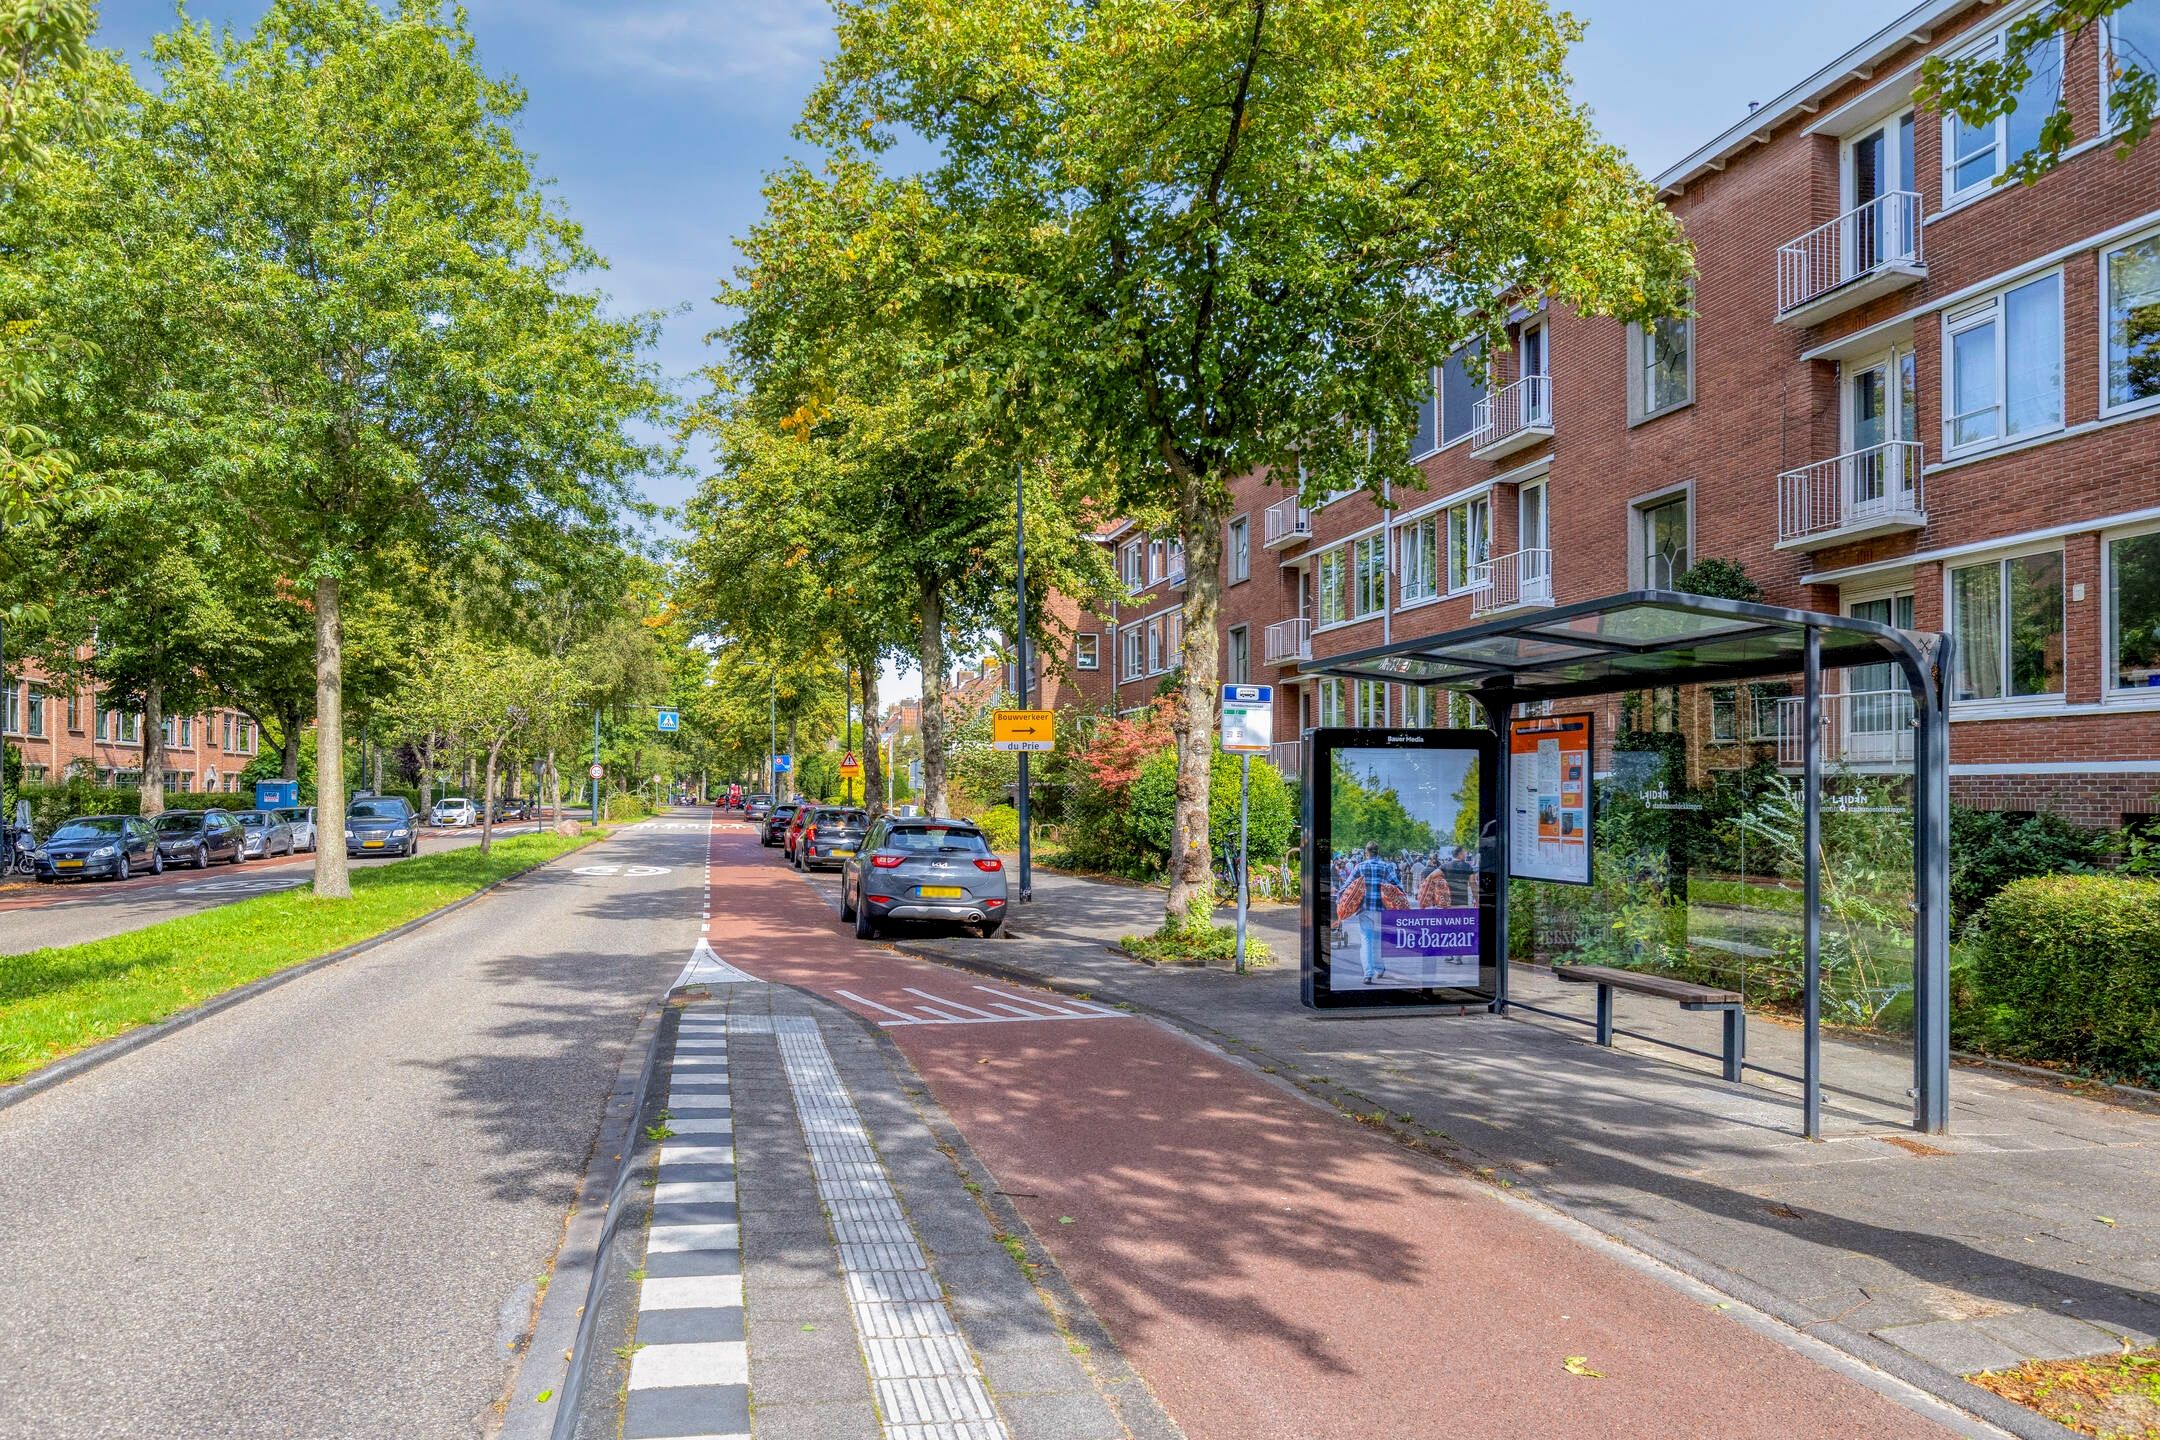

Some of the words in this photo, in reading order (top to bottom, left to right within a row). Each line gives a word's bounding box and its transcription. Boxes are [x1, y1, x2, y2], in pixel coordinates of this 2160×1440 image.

[1007, 742, 1019, 750] du
[1022, 741, 1040, 750] Prie
[1395, 917, 1442, 927] SCHATTEN
[1444, 917, 1461, 926] VAN
[1463, 916, 1475, 925] DE
[1395, 928, 1416, 949] De
[1417, 927, 1475, 948] Bazaar
